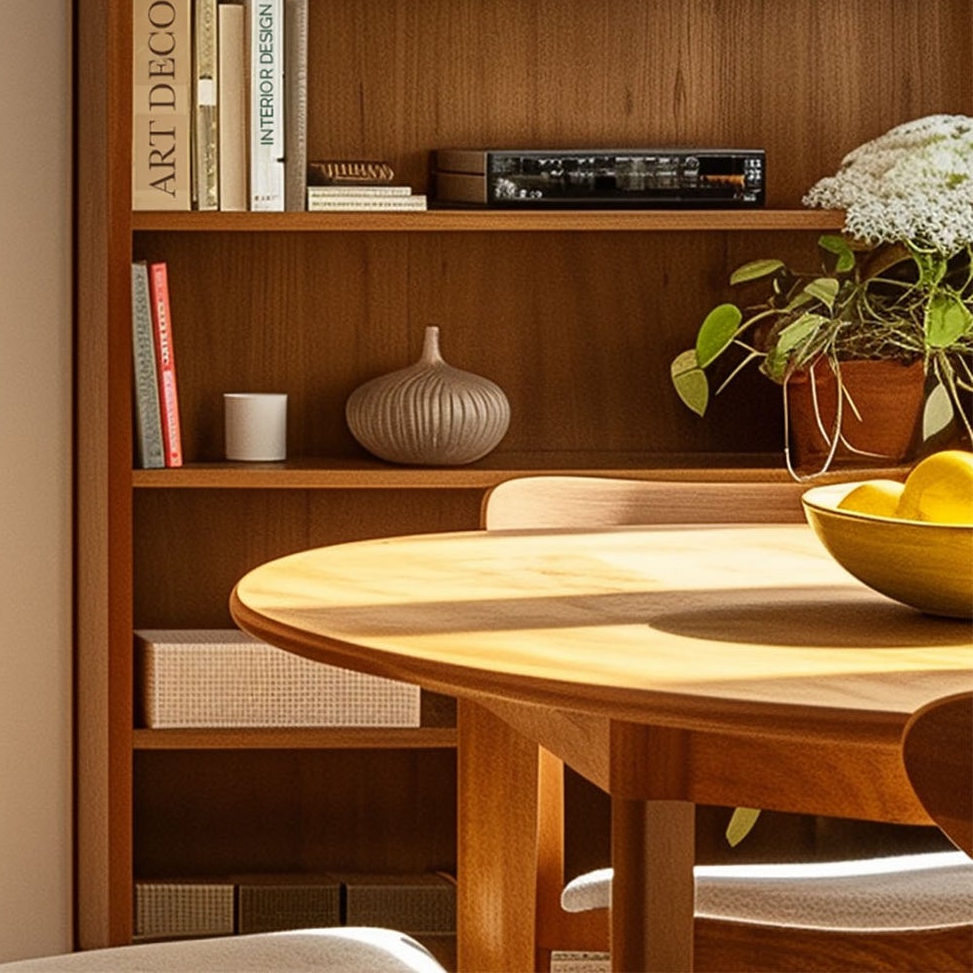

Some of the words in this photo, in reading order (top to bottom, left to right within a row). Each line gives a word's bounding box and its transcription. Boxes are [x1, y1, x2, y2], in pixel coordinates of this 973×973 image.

[148, 0, 176, 111] DECO
[259, 4, 273, 64] DESIGN
[259, 68, 274, 145] INTERIOR
[148, 120, 176, 198] ART
